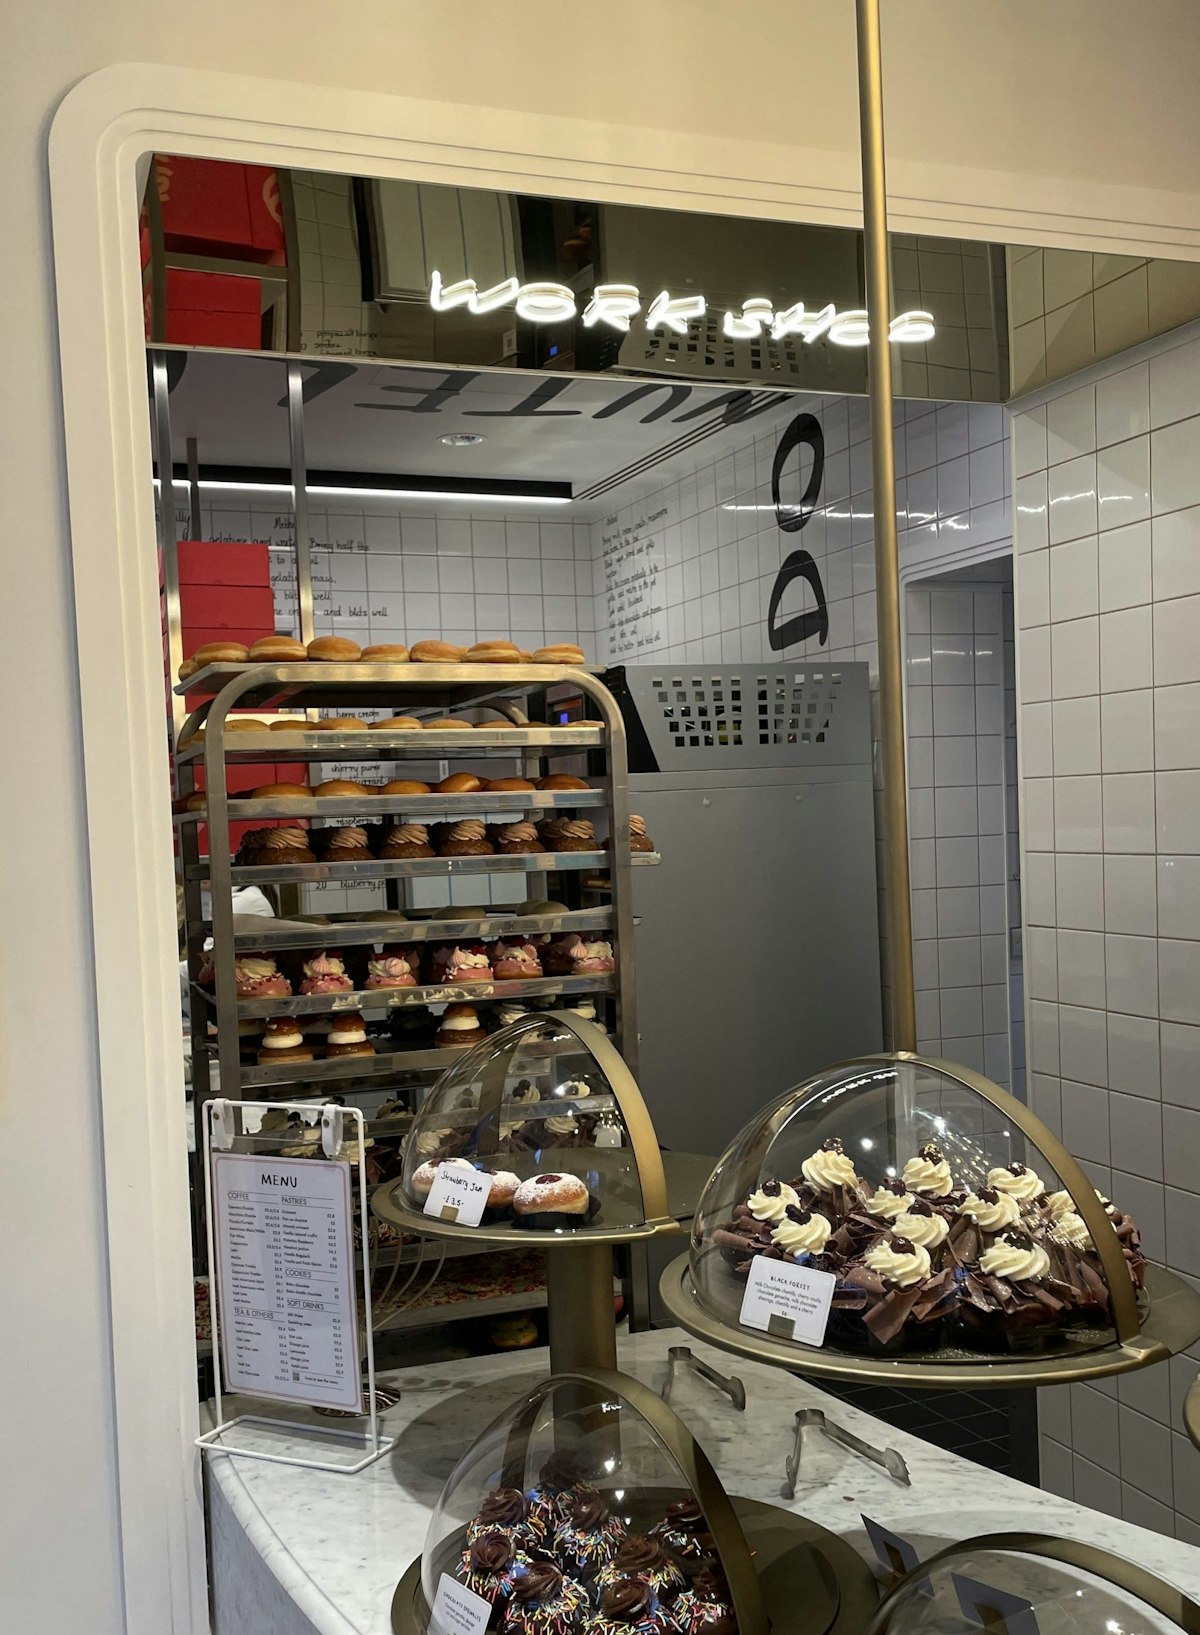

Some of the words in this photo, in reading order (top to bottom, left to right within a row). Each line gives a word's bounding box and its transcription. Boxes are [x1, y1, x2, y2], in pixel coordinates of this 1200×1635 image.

[323, 604, 342, 617] and
[261, 1173, 297, 1188] MENU
[228, 1191, 250, 1201] COFFEE
[281, 1196, 307, 1205] PASTRIES
[285, 1269, 311, 1278] COOKIES
[770, 1276, 788, 1285] BLACK
[789, 1280, 811, 1291] FOREST
[287, 1299, 301, 1307] SOFT
[303, 1301, 325, 1311] DRINKS
